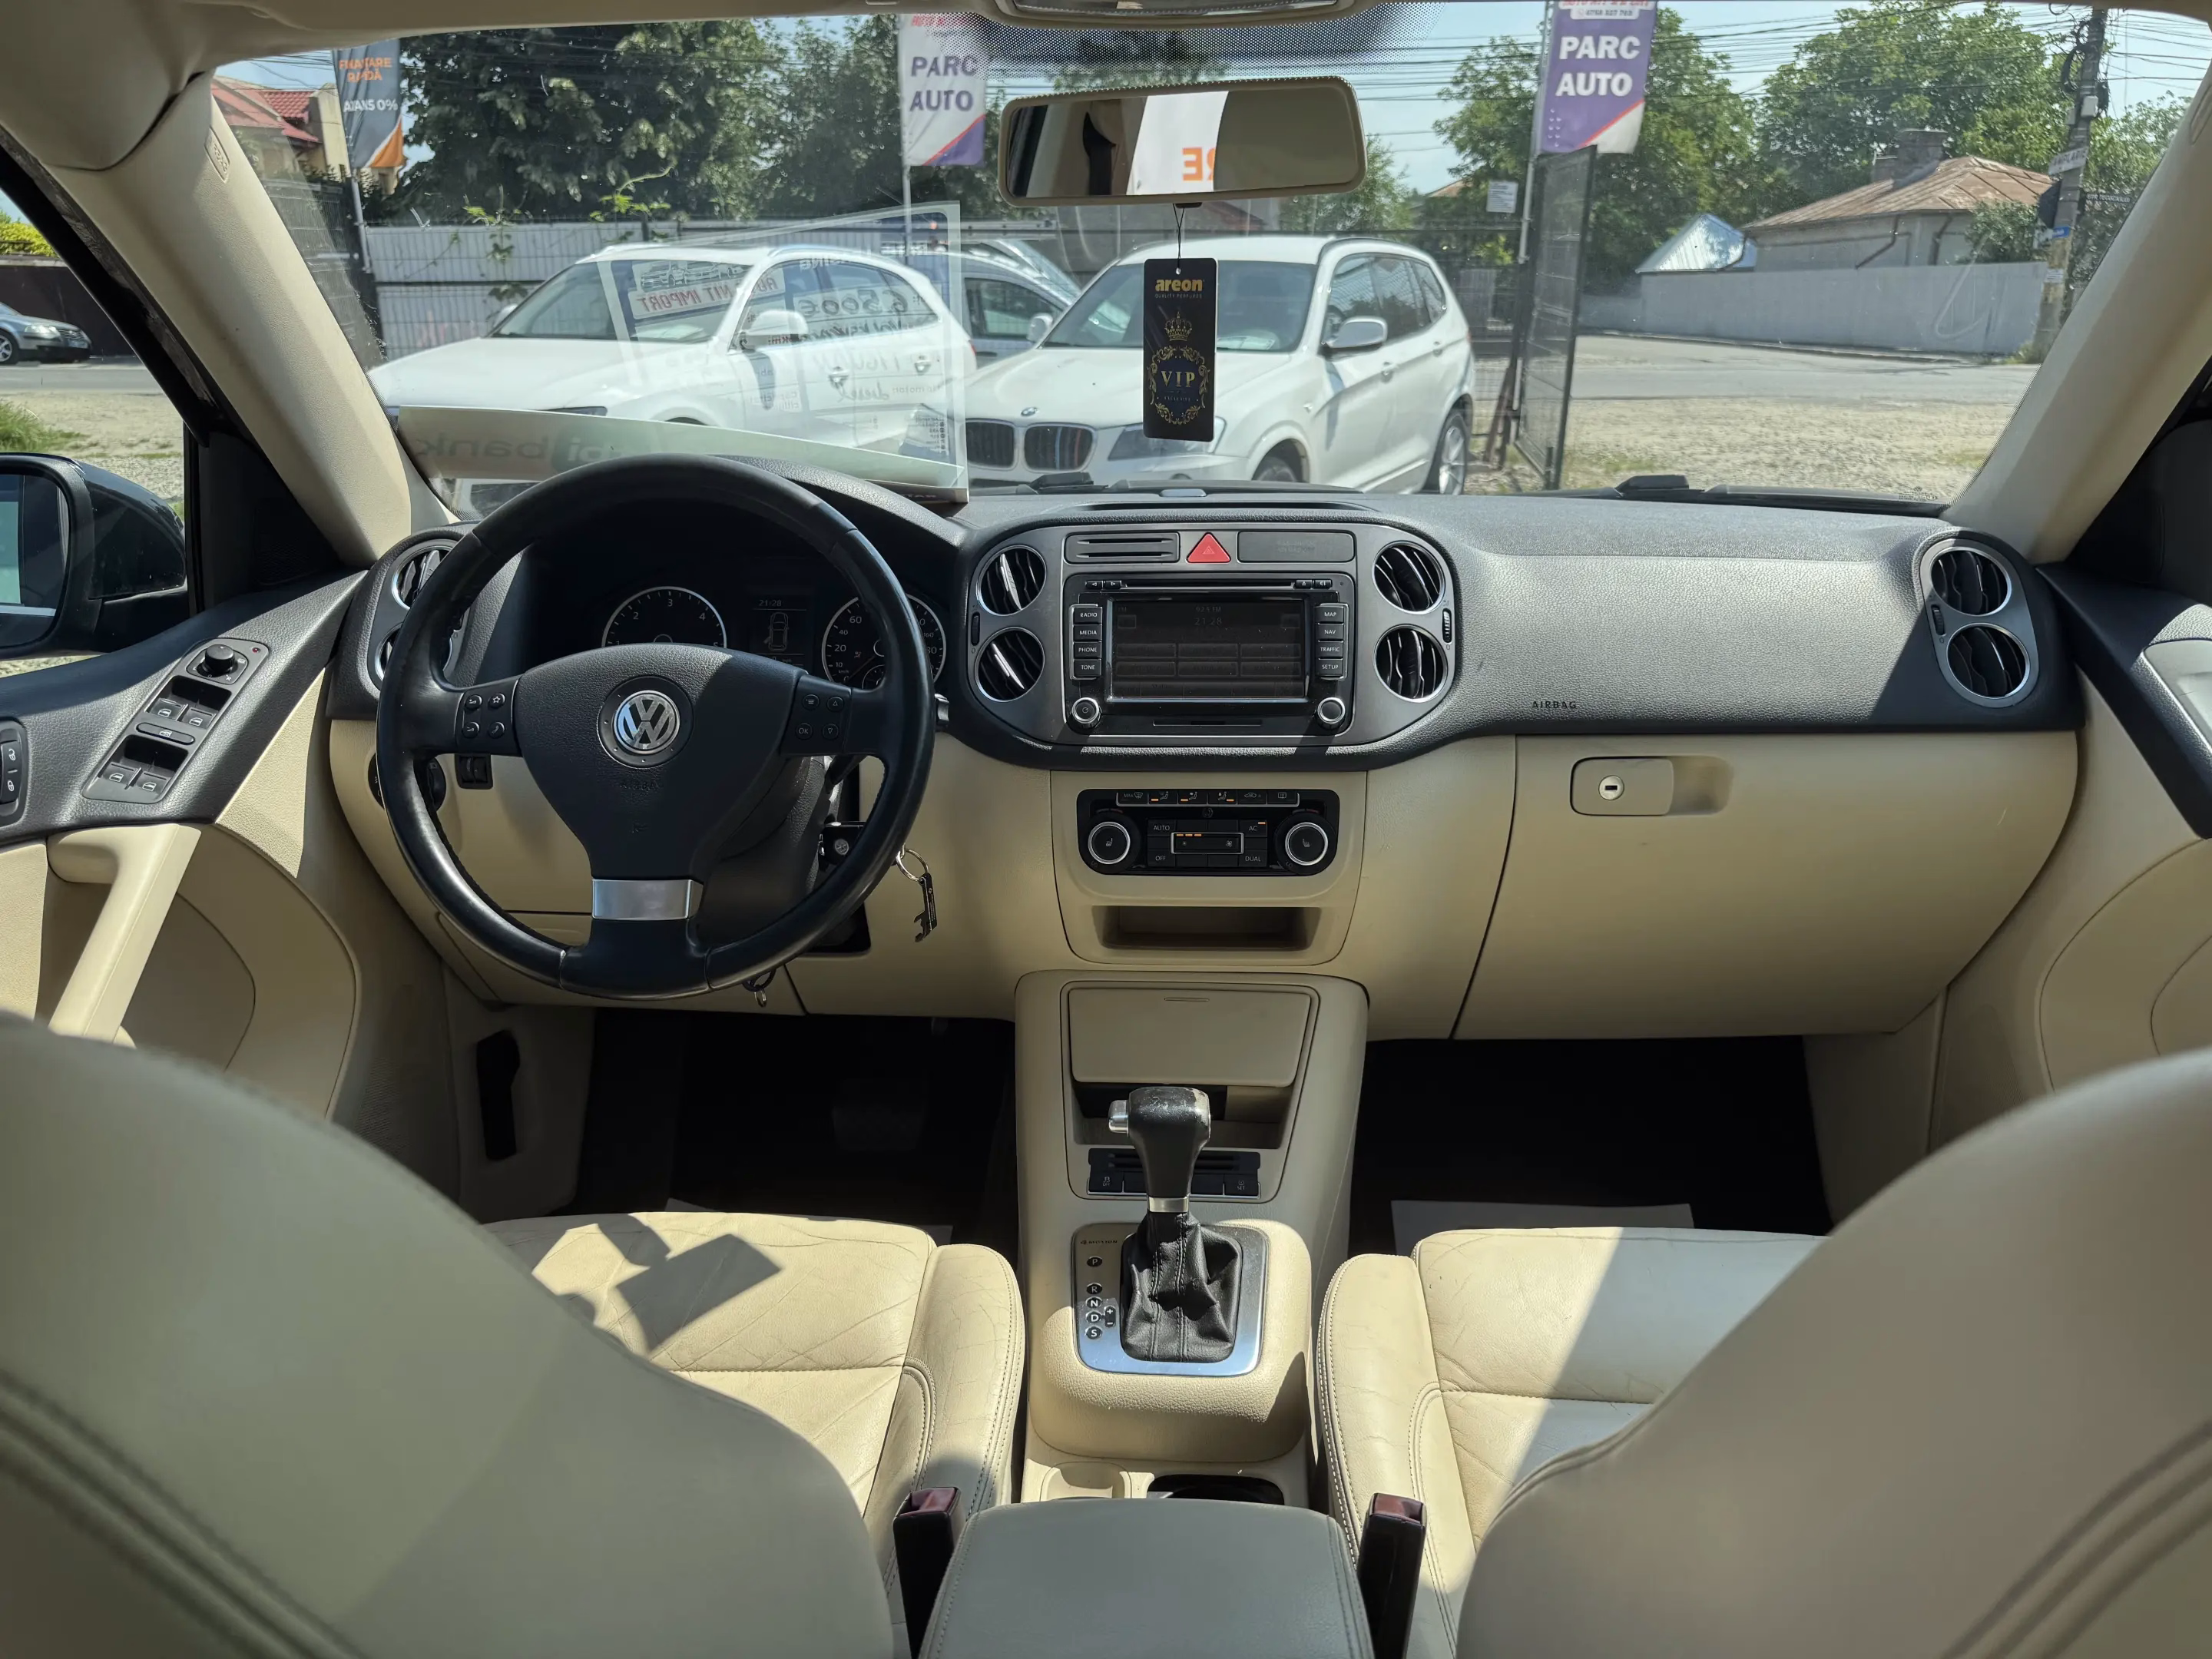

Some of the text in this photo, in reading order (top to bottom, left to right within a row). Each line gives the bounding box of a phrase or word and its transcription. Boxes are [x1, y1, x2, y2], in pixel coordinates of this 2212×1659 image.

[1559, 35, 1641, 59] PARC
[911, 56, 976, 77] PARC
[1555, 72, 1633, 97] AUTO
[376, 98, 399, 111] 0%
[909, 90, 973, 111] AUTO
[1155, 279, 1203, 291] areon
[1161, 370, 1195, 387] VIP
[667, 598, 673, 608] 3
[633, 611, 639, 620] 2
[698, 612, 707, 621] 4
[834, 644, 846, 652] 20
[1532, 700, 1577, 709] AIRBAG
[1091, 1329, 1098, 1337] S
